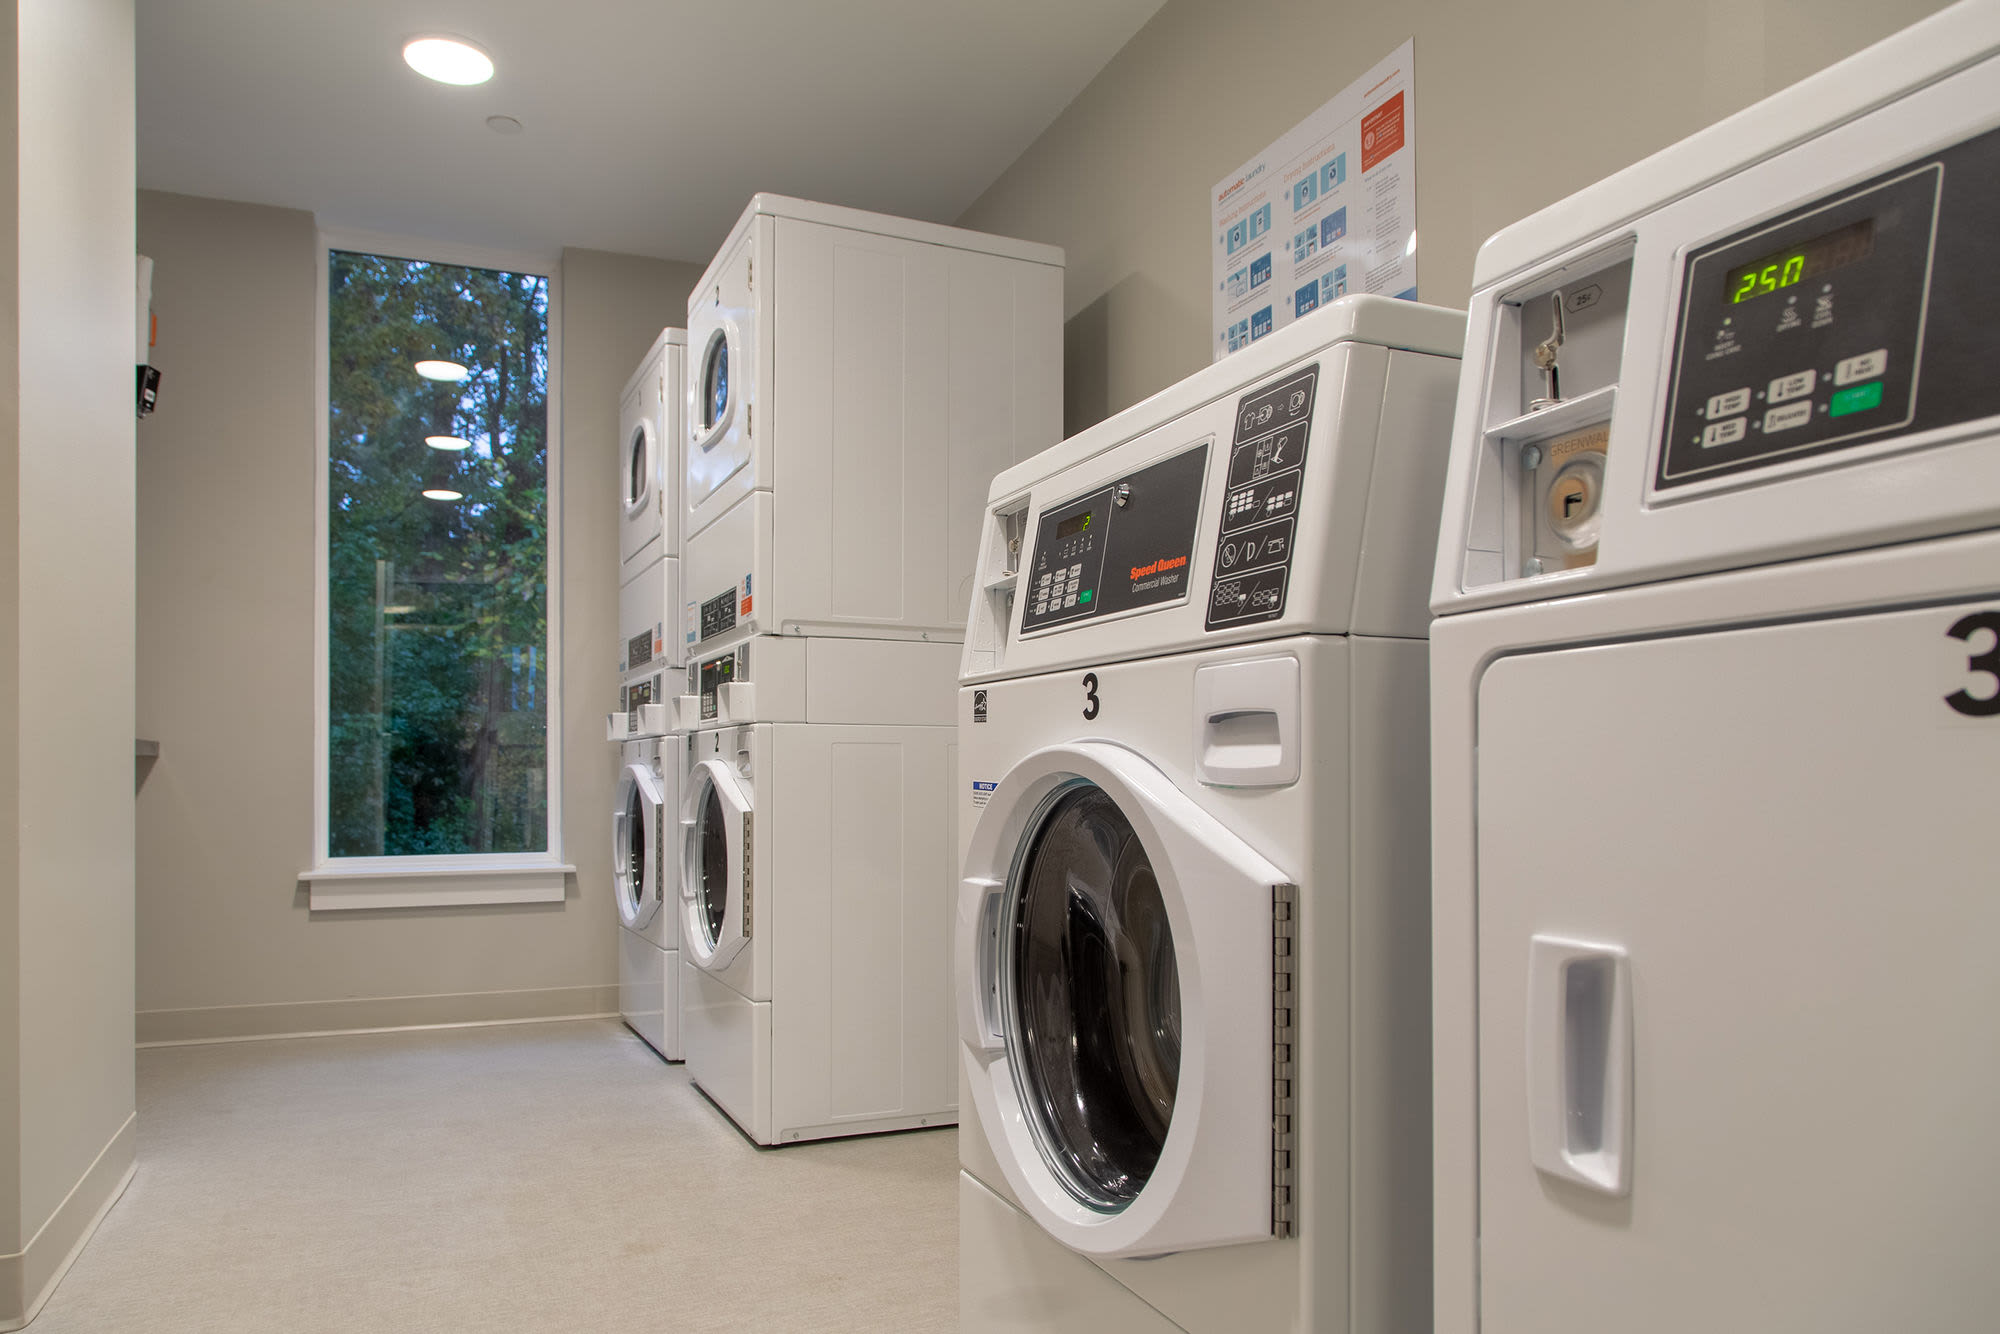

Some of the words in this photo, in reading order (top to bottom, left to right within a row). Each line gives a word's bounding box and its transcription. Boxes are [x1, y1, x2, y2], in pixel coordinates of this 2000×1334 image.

[1218, 178, 1245, 202] automatic
[1733, 255, 1805, 304] 250
[1130, 561, 1158, 581] Speed
[1157, 555, 1187, 571] Queen
[1132, 577, 1160, 592] Commercial
[1160, 574, 1179, 586] Washer
[1945, 611, 2000, 716] 3
[1082, 672, 1100, 721] 3
[715, 732, 720, 753] 2
